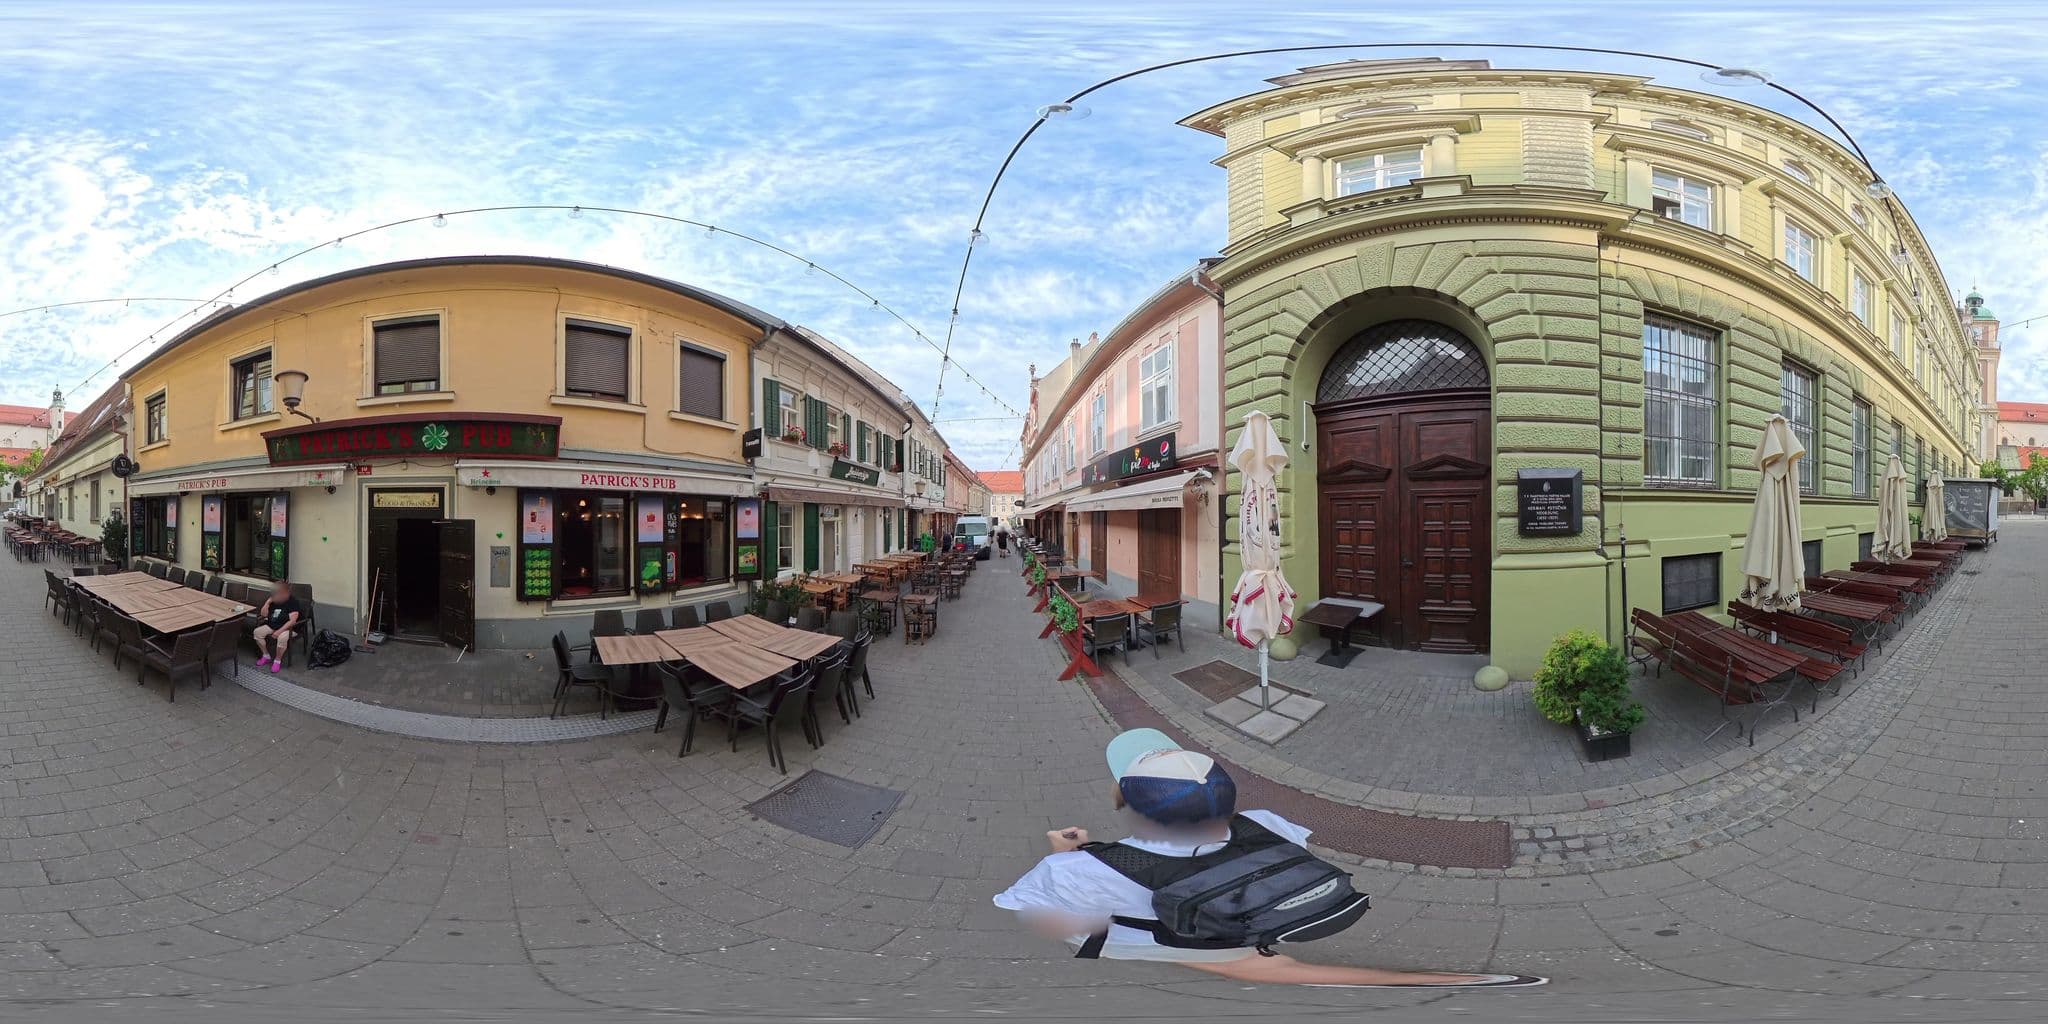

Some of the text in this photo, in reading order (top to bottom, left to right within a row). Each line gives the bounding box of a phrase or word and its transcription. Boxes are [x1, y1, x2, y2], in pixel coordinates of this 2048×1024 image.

[300, 424, 512, 455] PATRICK'S PUB
[178, 478, 227, 490] PATRICK'S PUB
[581, 473, 676, 489] PATRICK'S PUB
